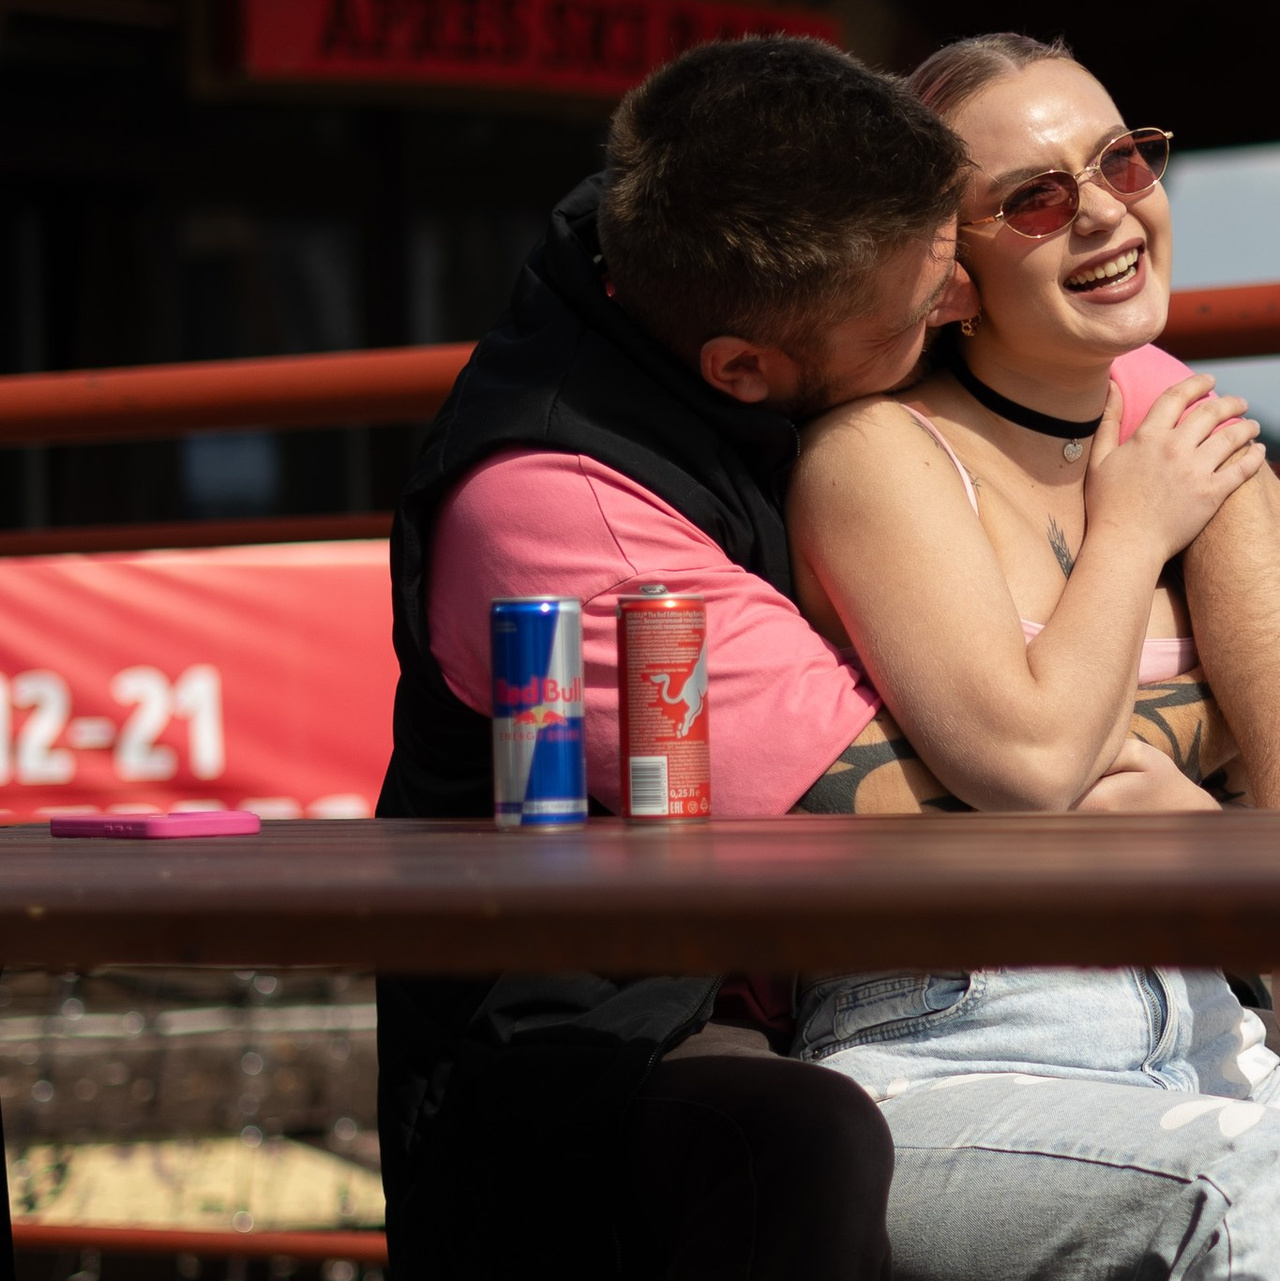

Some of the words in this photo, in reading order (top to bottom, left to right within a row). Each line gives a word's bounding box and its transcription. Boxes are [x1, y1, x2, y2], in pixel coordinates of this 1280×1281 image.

[495, 676, 539, 706] Red
[542, 677, 582, 704] Bull
[0, 662, 226, 786] 2-21
[669, 788, 688, 799] 0,25
